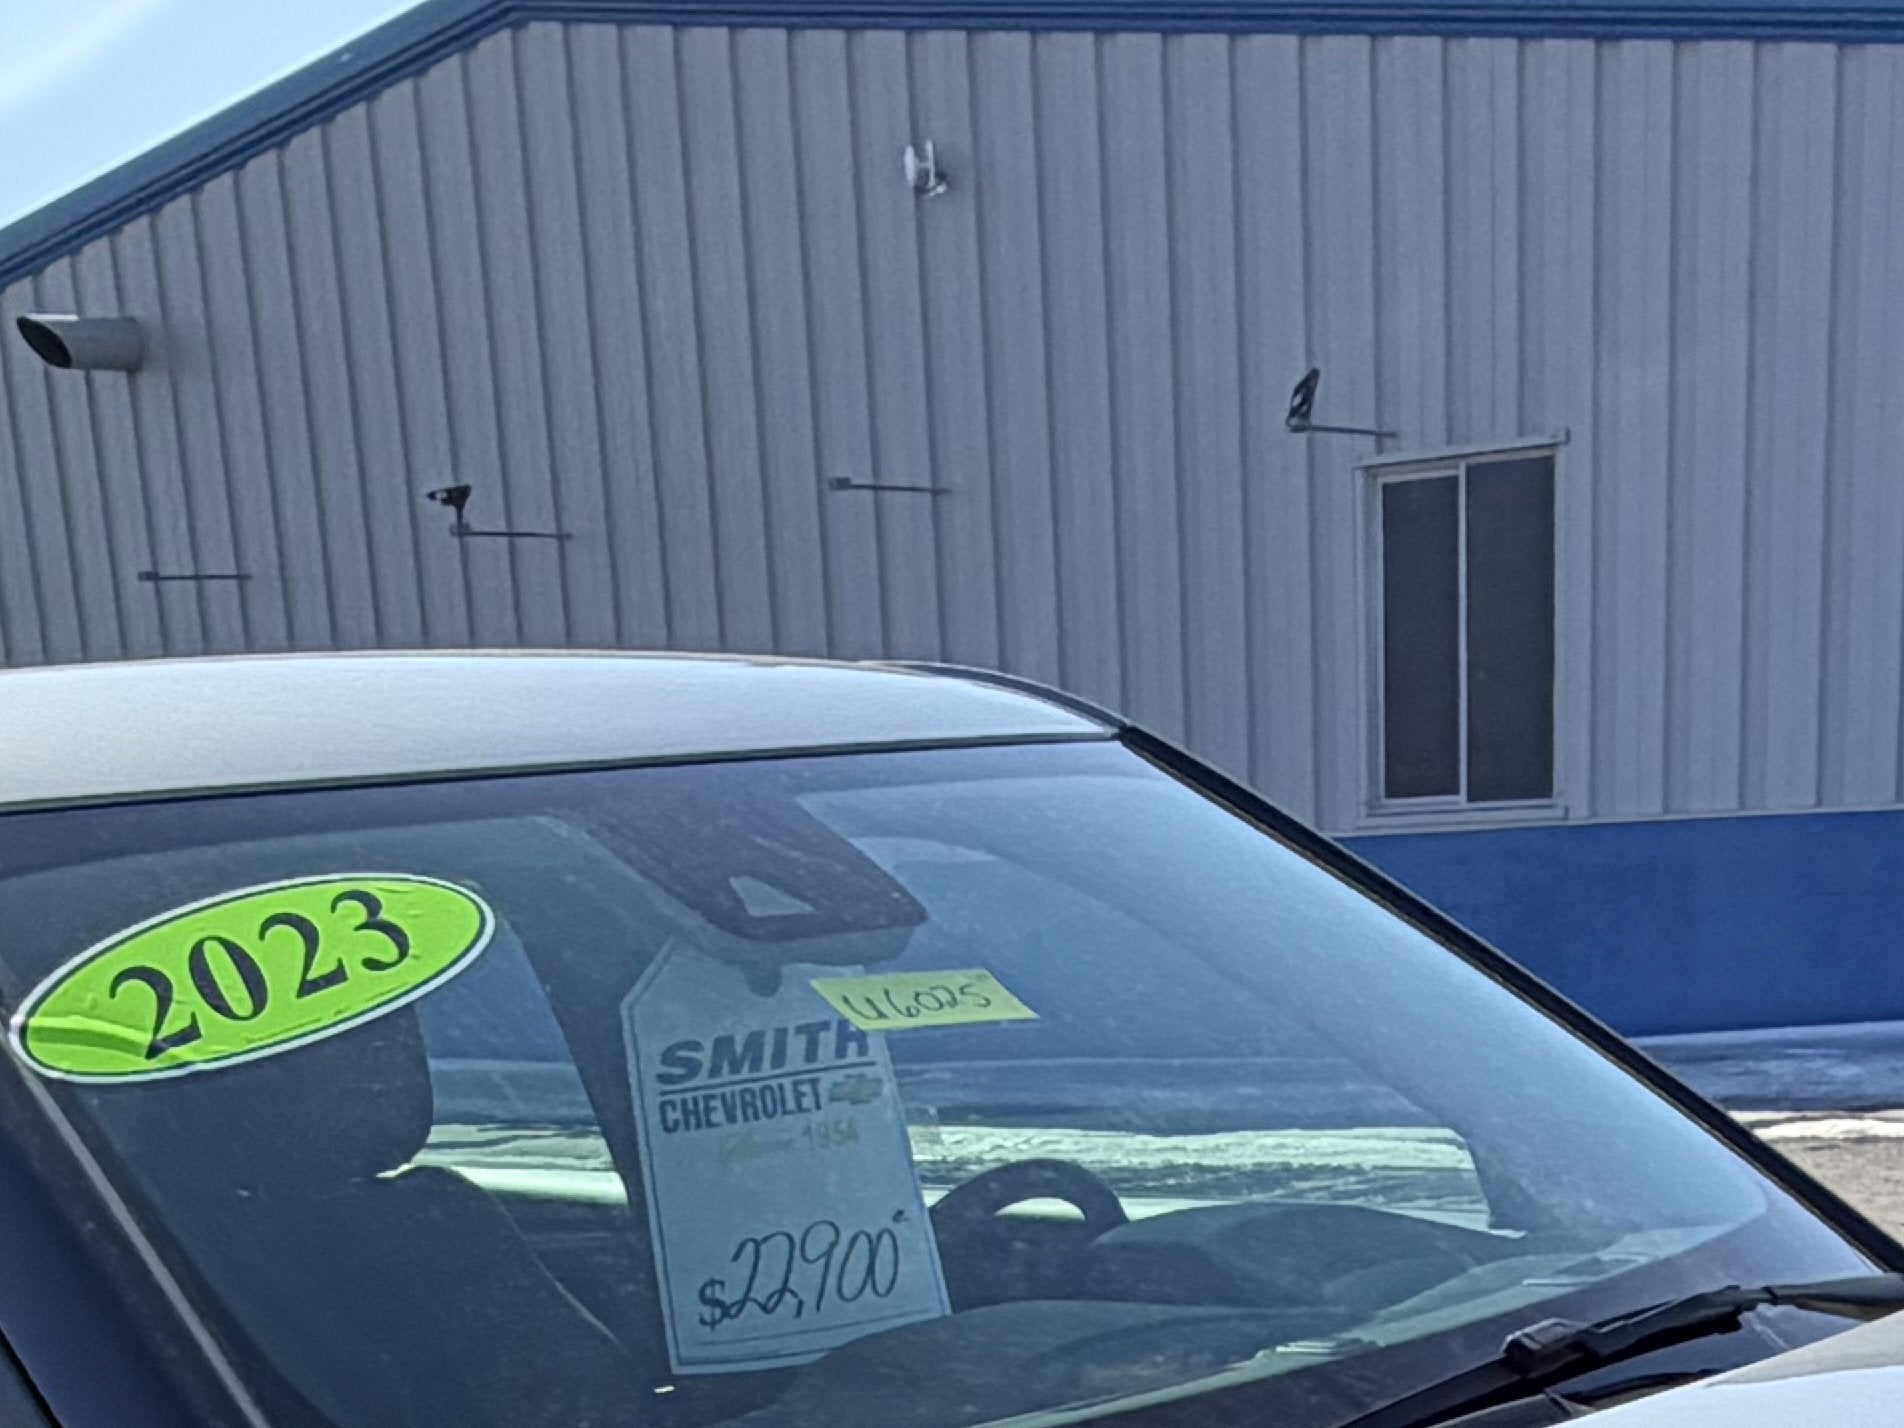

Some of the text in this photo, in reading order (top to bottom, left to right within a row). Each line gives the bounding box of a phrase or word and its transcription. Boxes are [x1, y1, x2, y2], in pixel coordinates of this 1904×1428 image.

[109, 889, 410, 1060] 2023
[656, 1019, 869, 1086] SMITH
[659, 1077, 823, 1134] CHEVROLET
